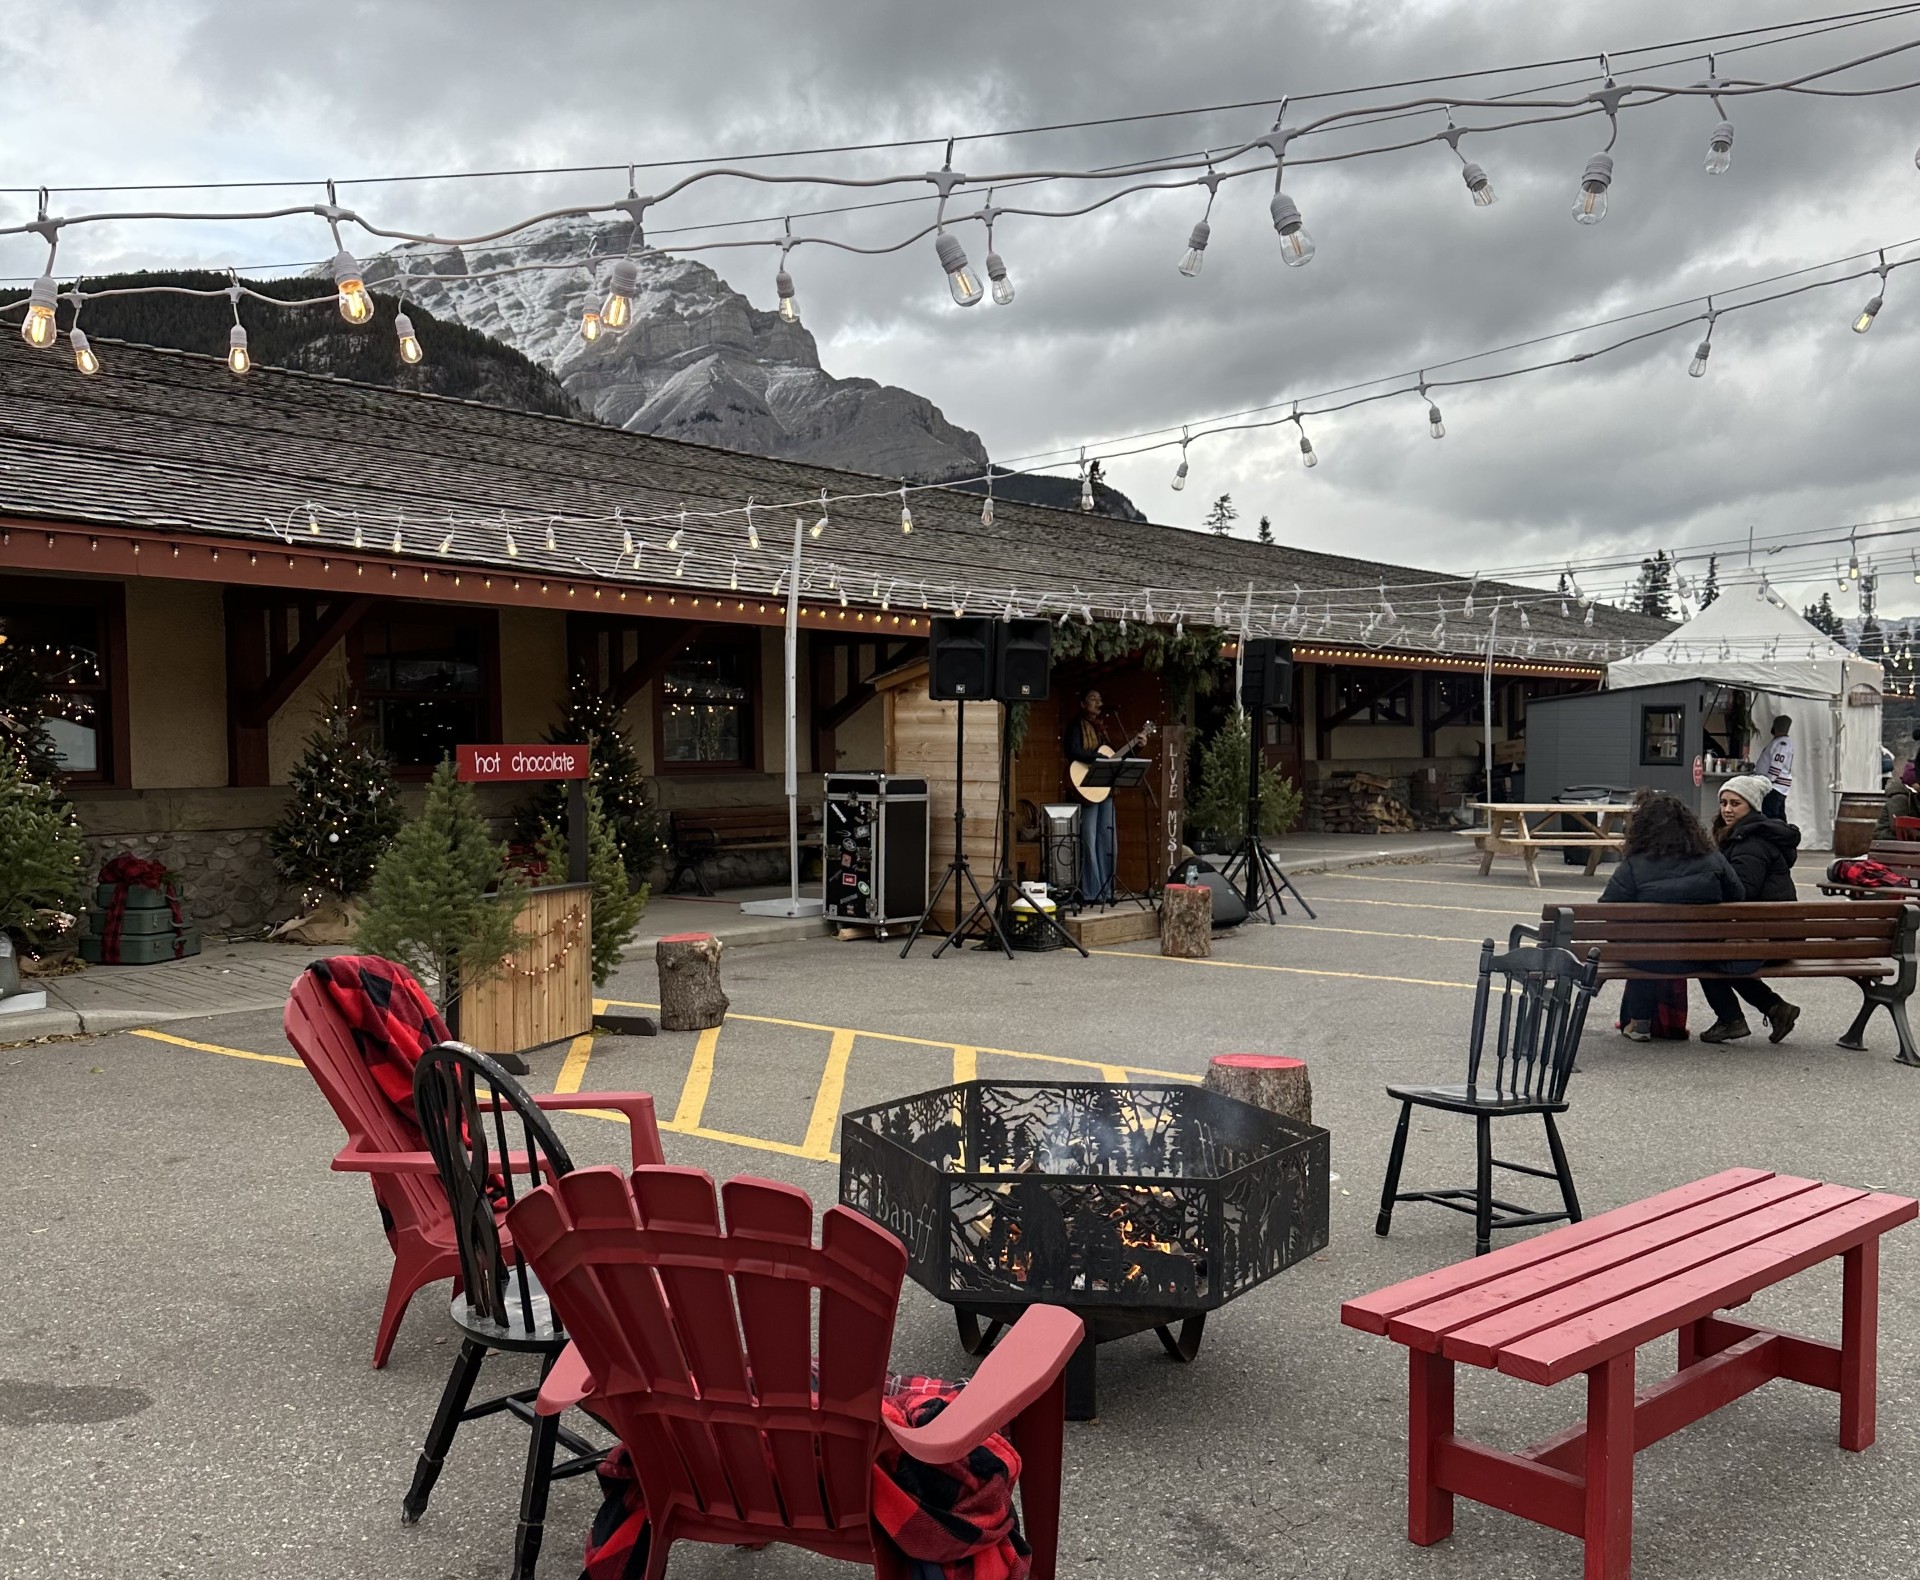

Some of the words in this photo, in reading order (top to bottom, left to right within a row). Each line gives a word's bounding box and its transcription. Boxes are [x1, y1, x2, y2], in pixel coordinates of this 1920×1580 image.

[474, 751, 501, 774] hot
[511, 751, 575, 773] chocolate
[1169, 743, 1177, 798] LIVE
[876, 1173, 937, 1264] Banff
